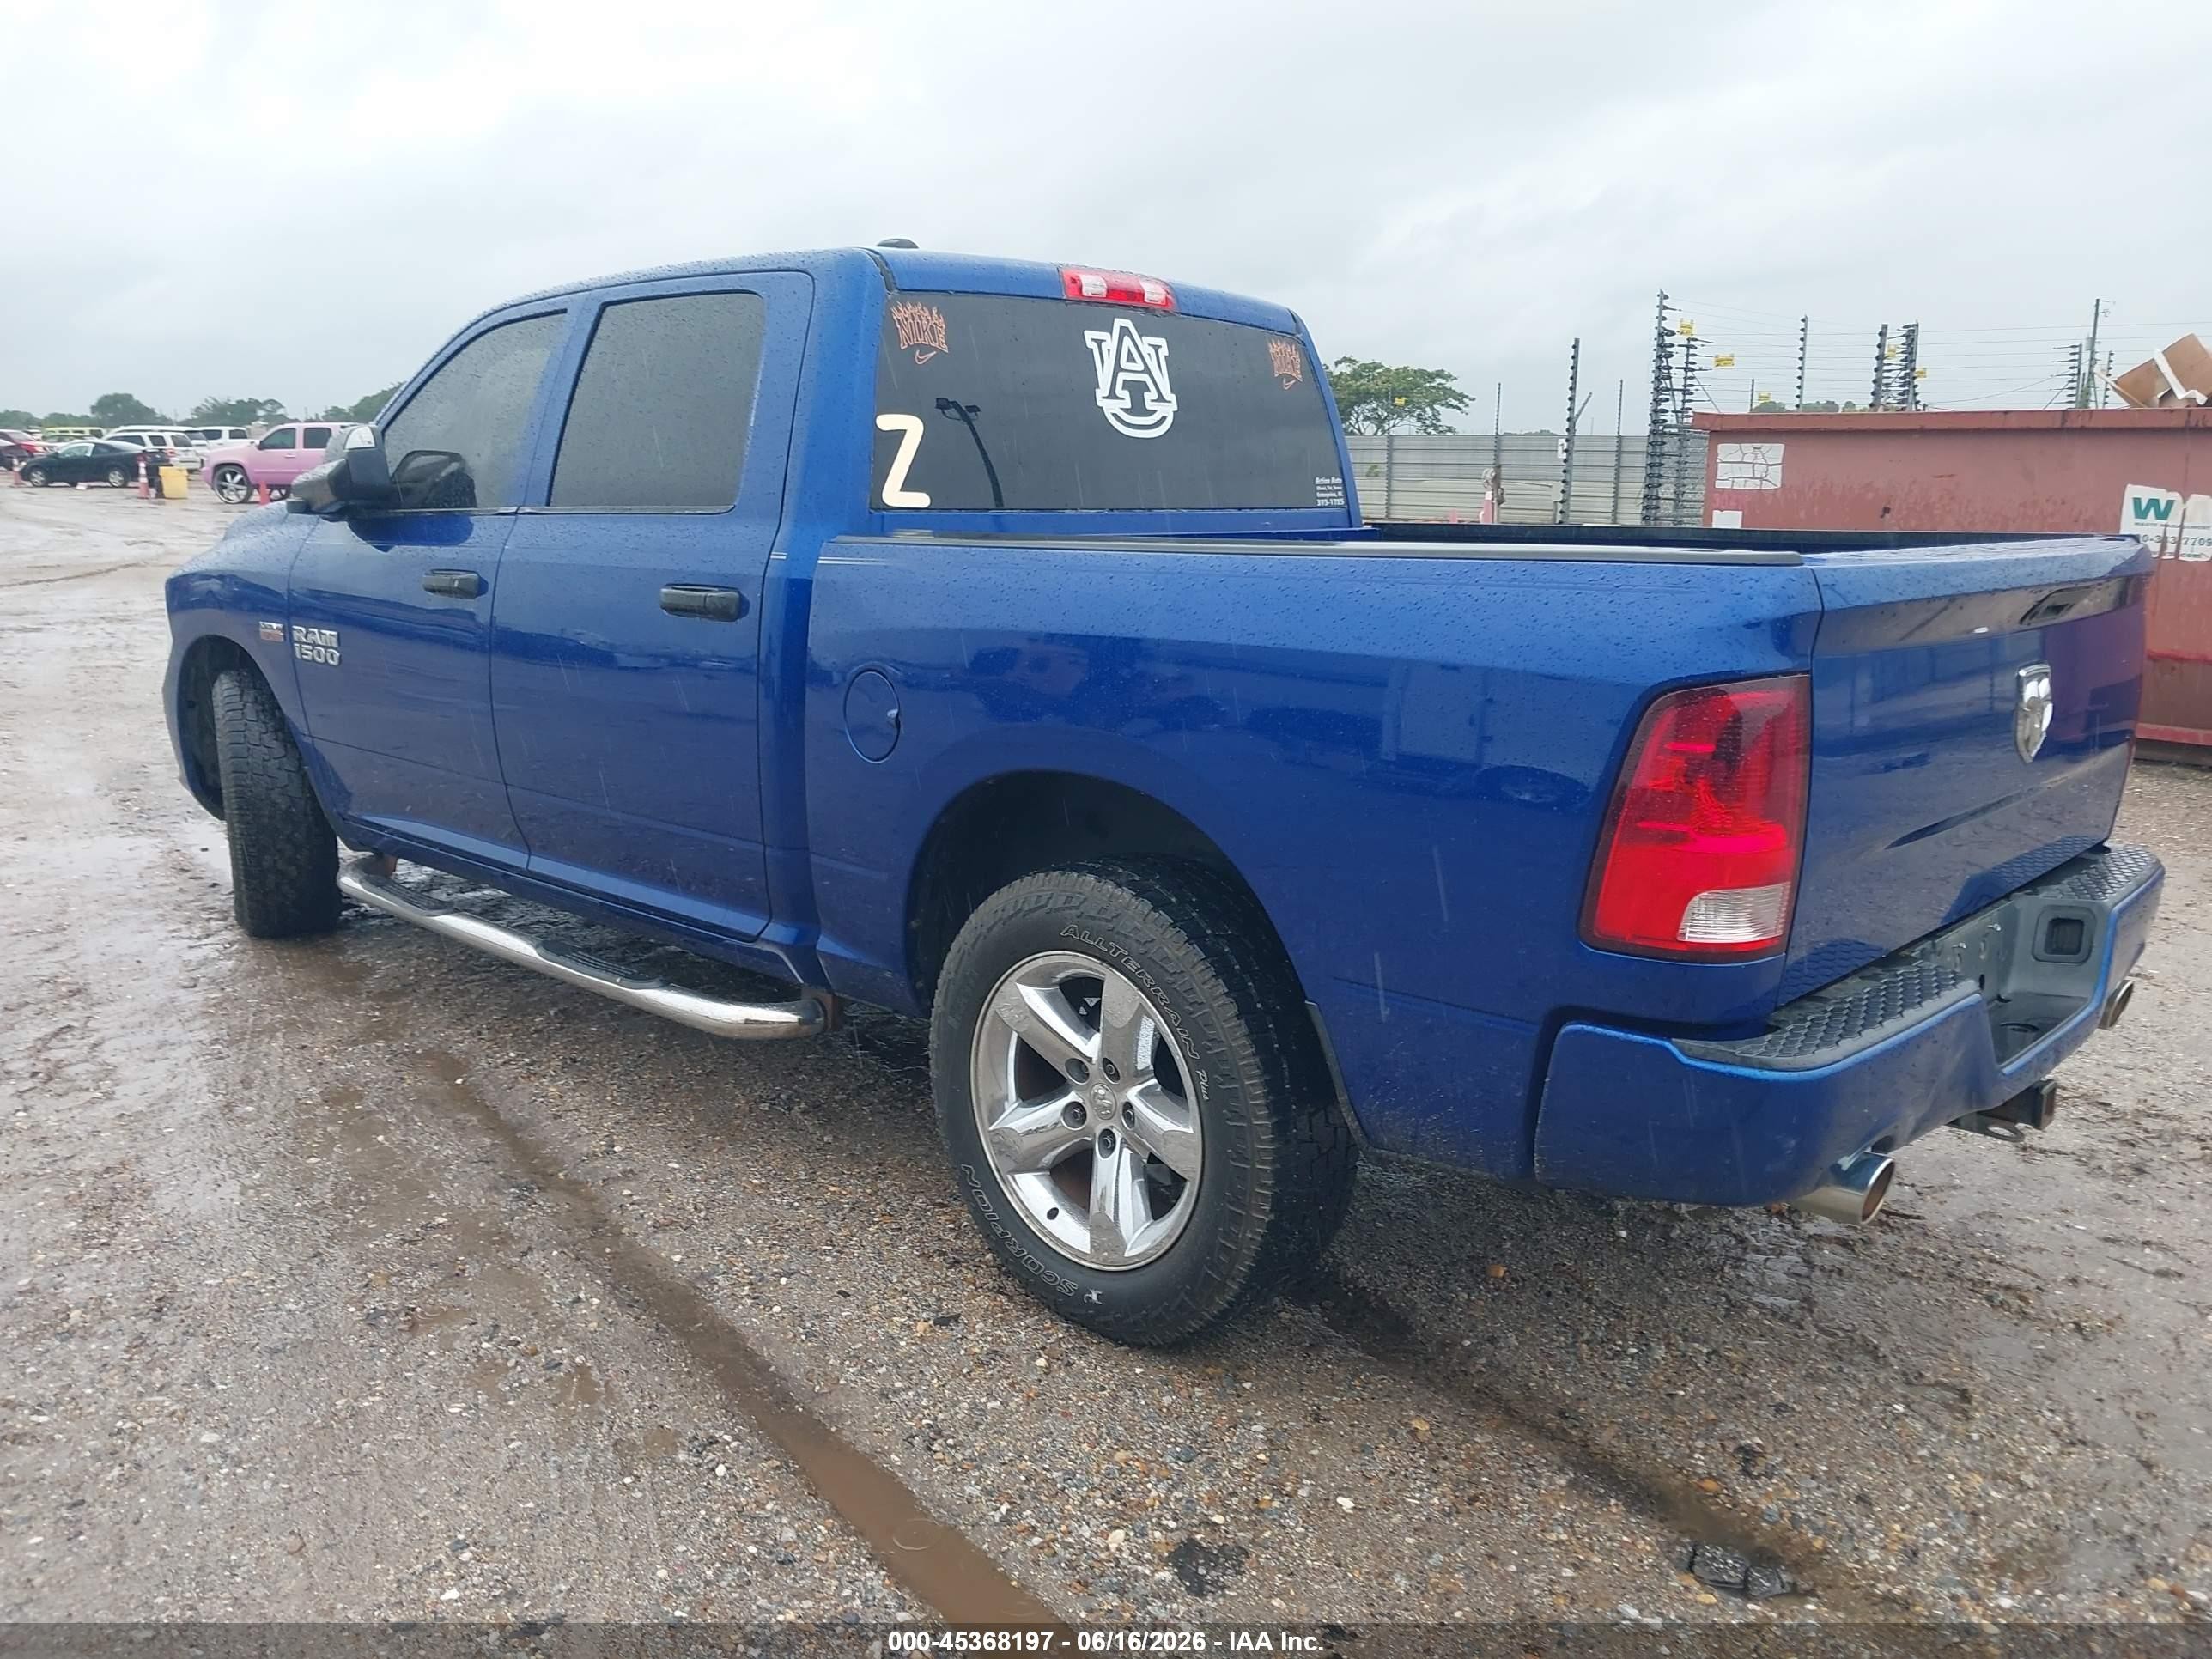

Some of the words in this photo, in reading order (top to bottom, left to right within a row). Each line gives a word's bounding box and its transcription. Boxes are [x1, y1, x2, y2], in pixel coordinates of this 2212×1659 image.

[890, 301, 949, 353] NIKE
[2132, 497, 2177, 521] W
[292, 625, 337, 647] RAM
[294, 643, 340, 666] 1500
[960, 1164, 1079, 1297] SCORPION
